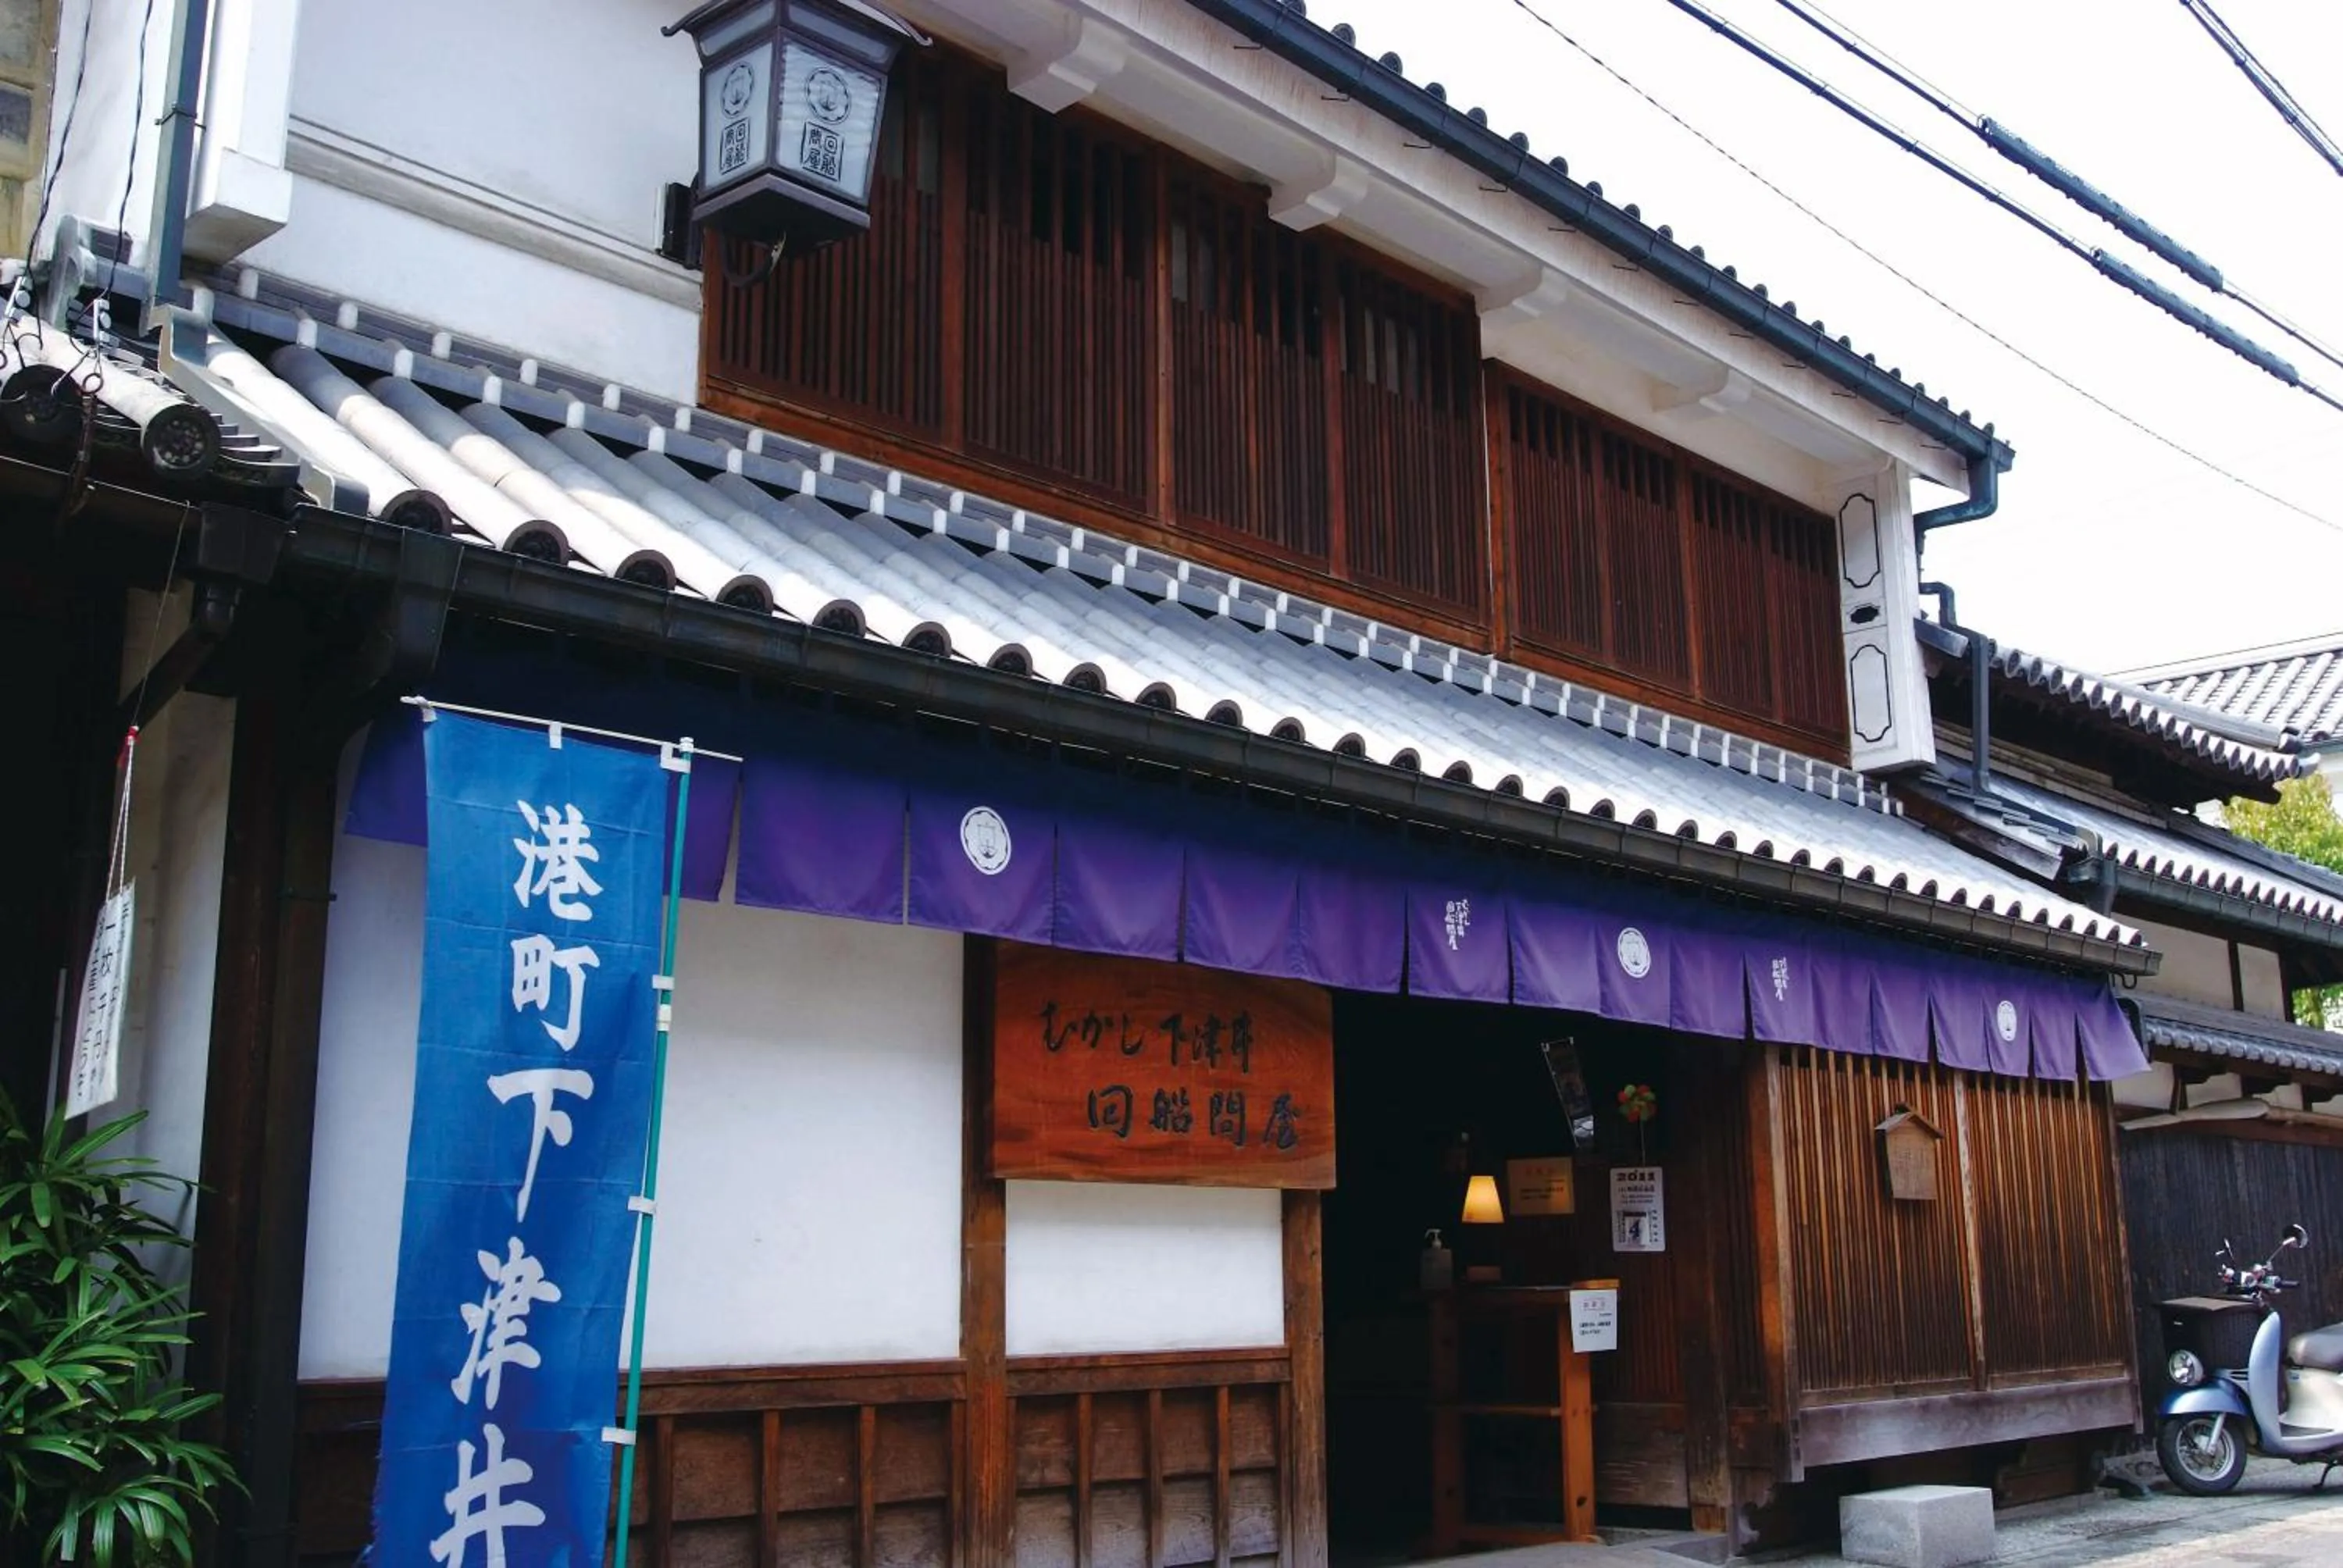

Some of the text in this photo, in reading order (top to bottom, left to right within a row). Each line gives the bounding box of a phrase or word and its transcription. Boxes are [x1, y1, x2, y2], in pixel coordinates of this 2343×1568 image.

[1086, 1084, 1301, 1151] 回船問屋
[429, 800, 603, 1568] 港町下津井
[1616, 1171, 1656, 1181] 2011
